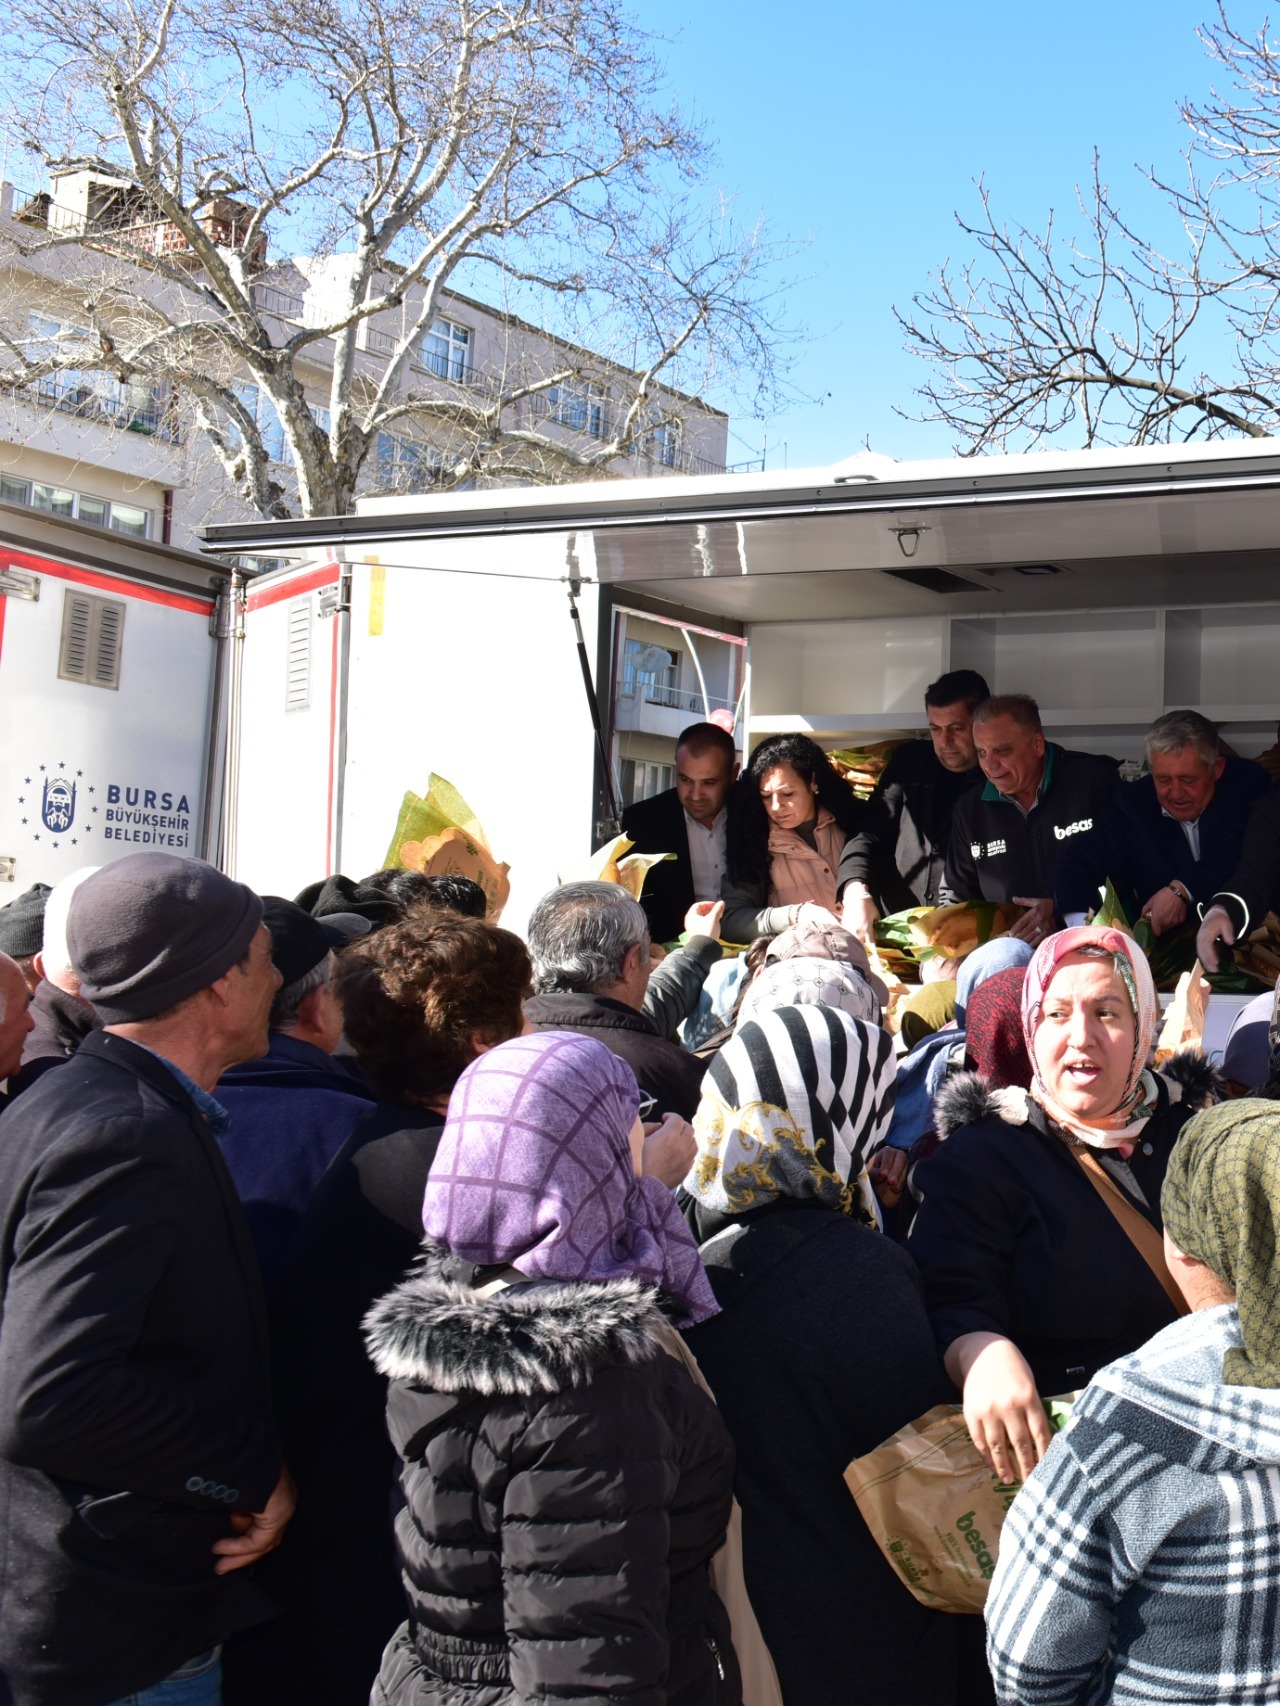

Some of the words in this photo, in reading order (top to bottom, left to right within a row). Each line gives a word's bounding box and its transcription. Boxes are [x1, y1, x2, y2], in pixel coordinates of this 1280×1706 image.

[107, 784, 190, 814] BURSA
[106, 806, 189, 831] BÜYÜKŞEHİR
[104, 826, 188, 848] BELEDİYESİ
